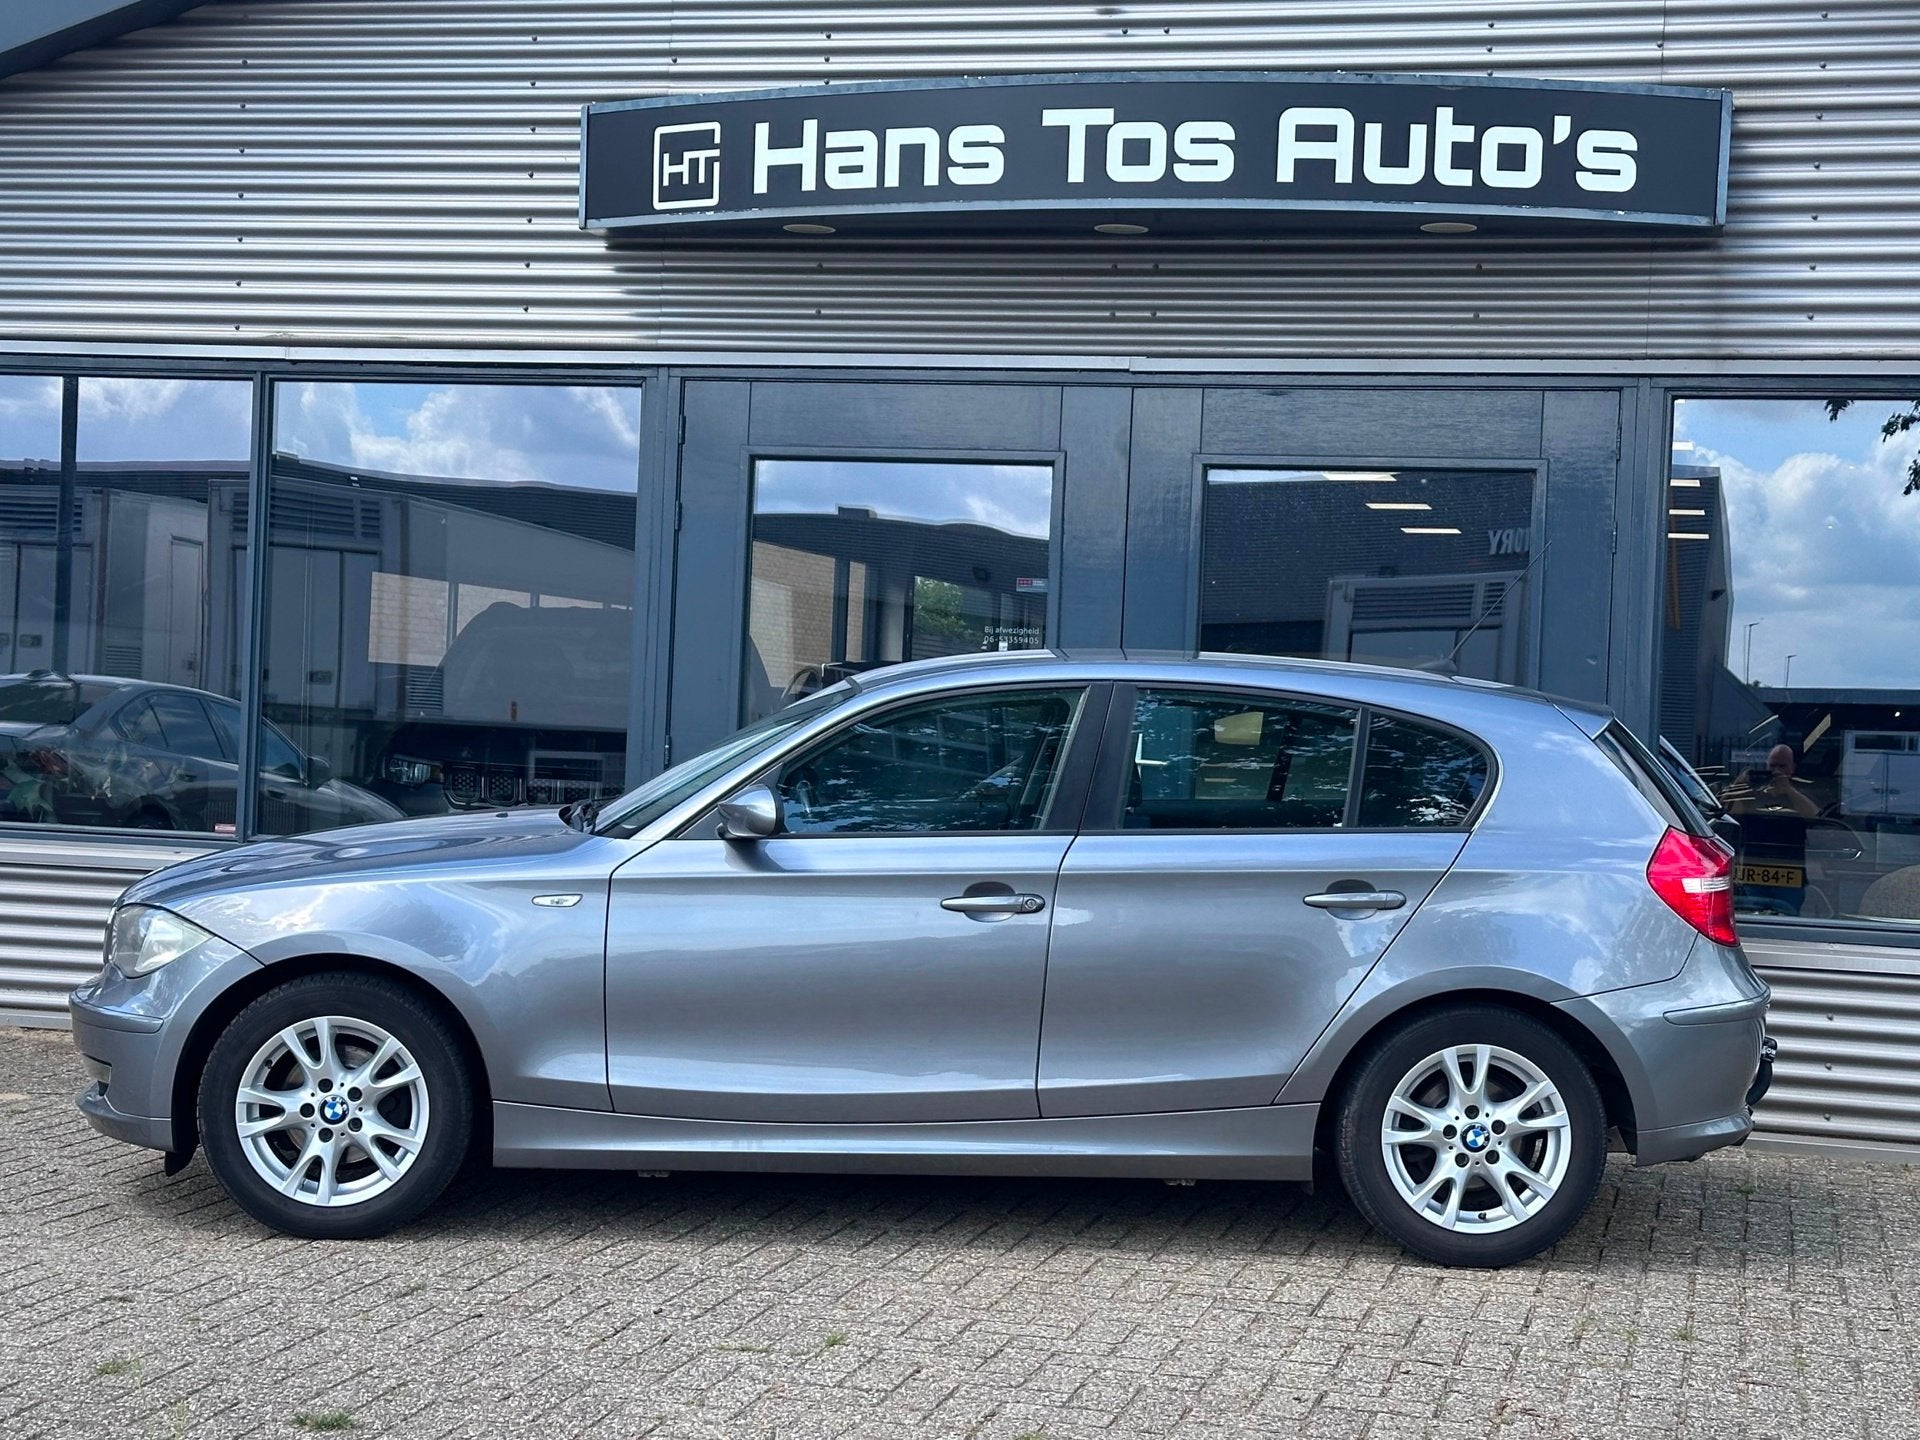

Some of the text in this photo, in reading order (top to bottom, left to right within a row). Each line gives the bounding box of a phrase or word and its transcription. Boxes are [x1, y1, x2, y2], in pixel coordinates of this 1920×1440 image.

[753, 106, 1638, 194] Hans Tos Auto's
[995, 626, 1040, 636] afwezigheid
